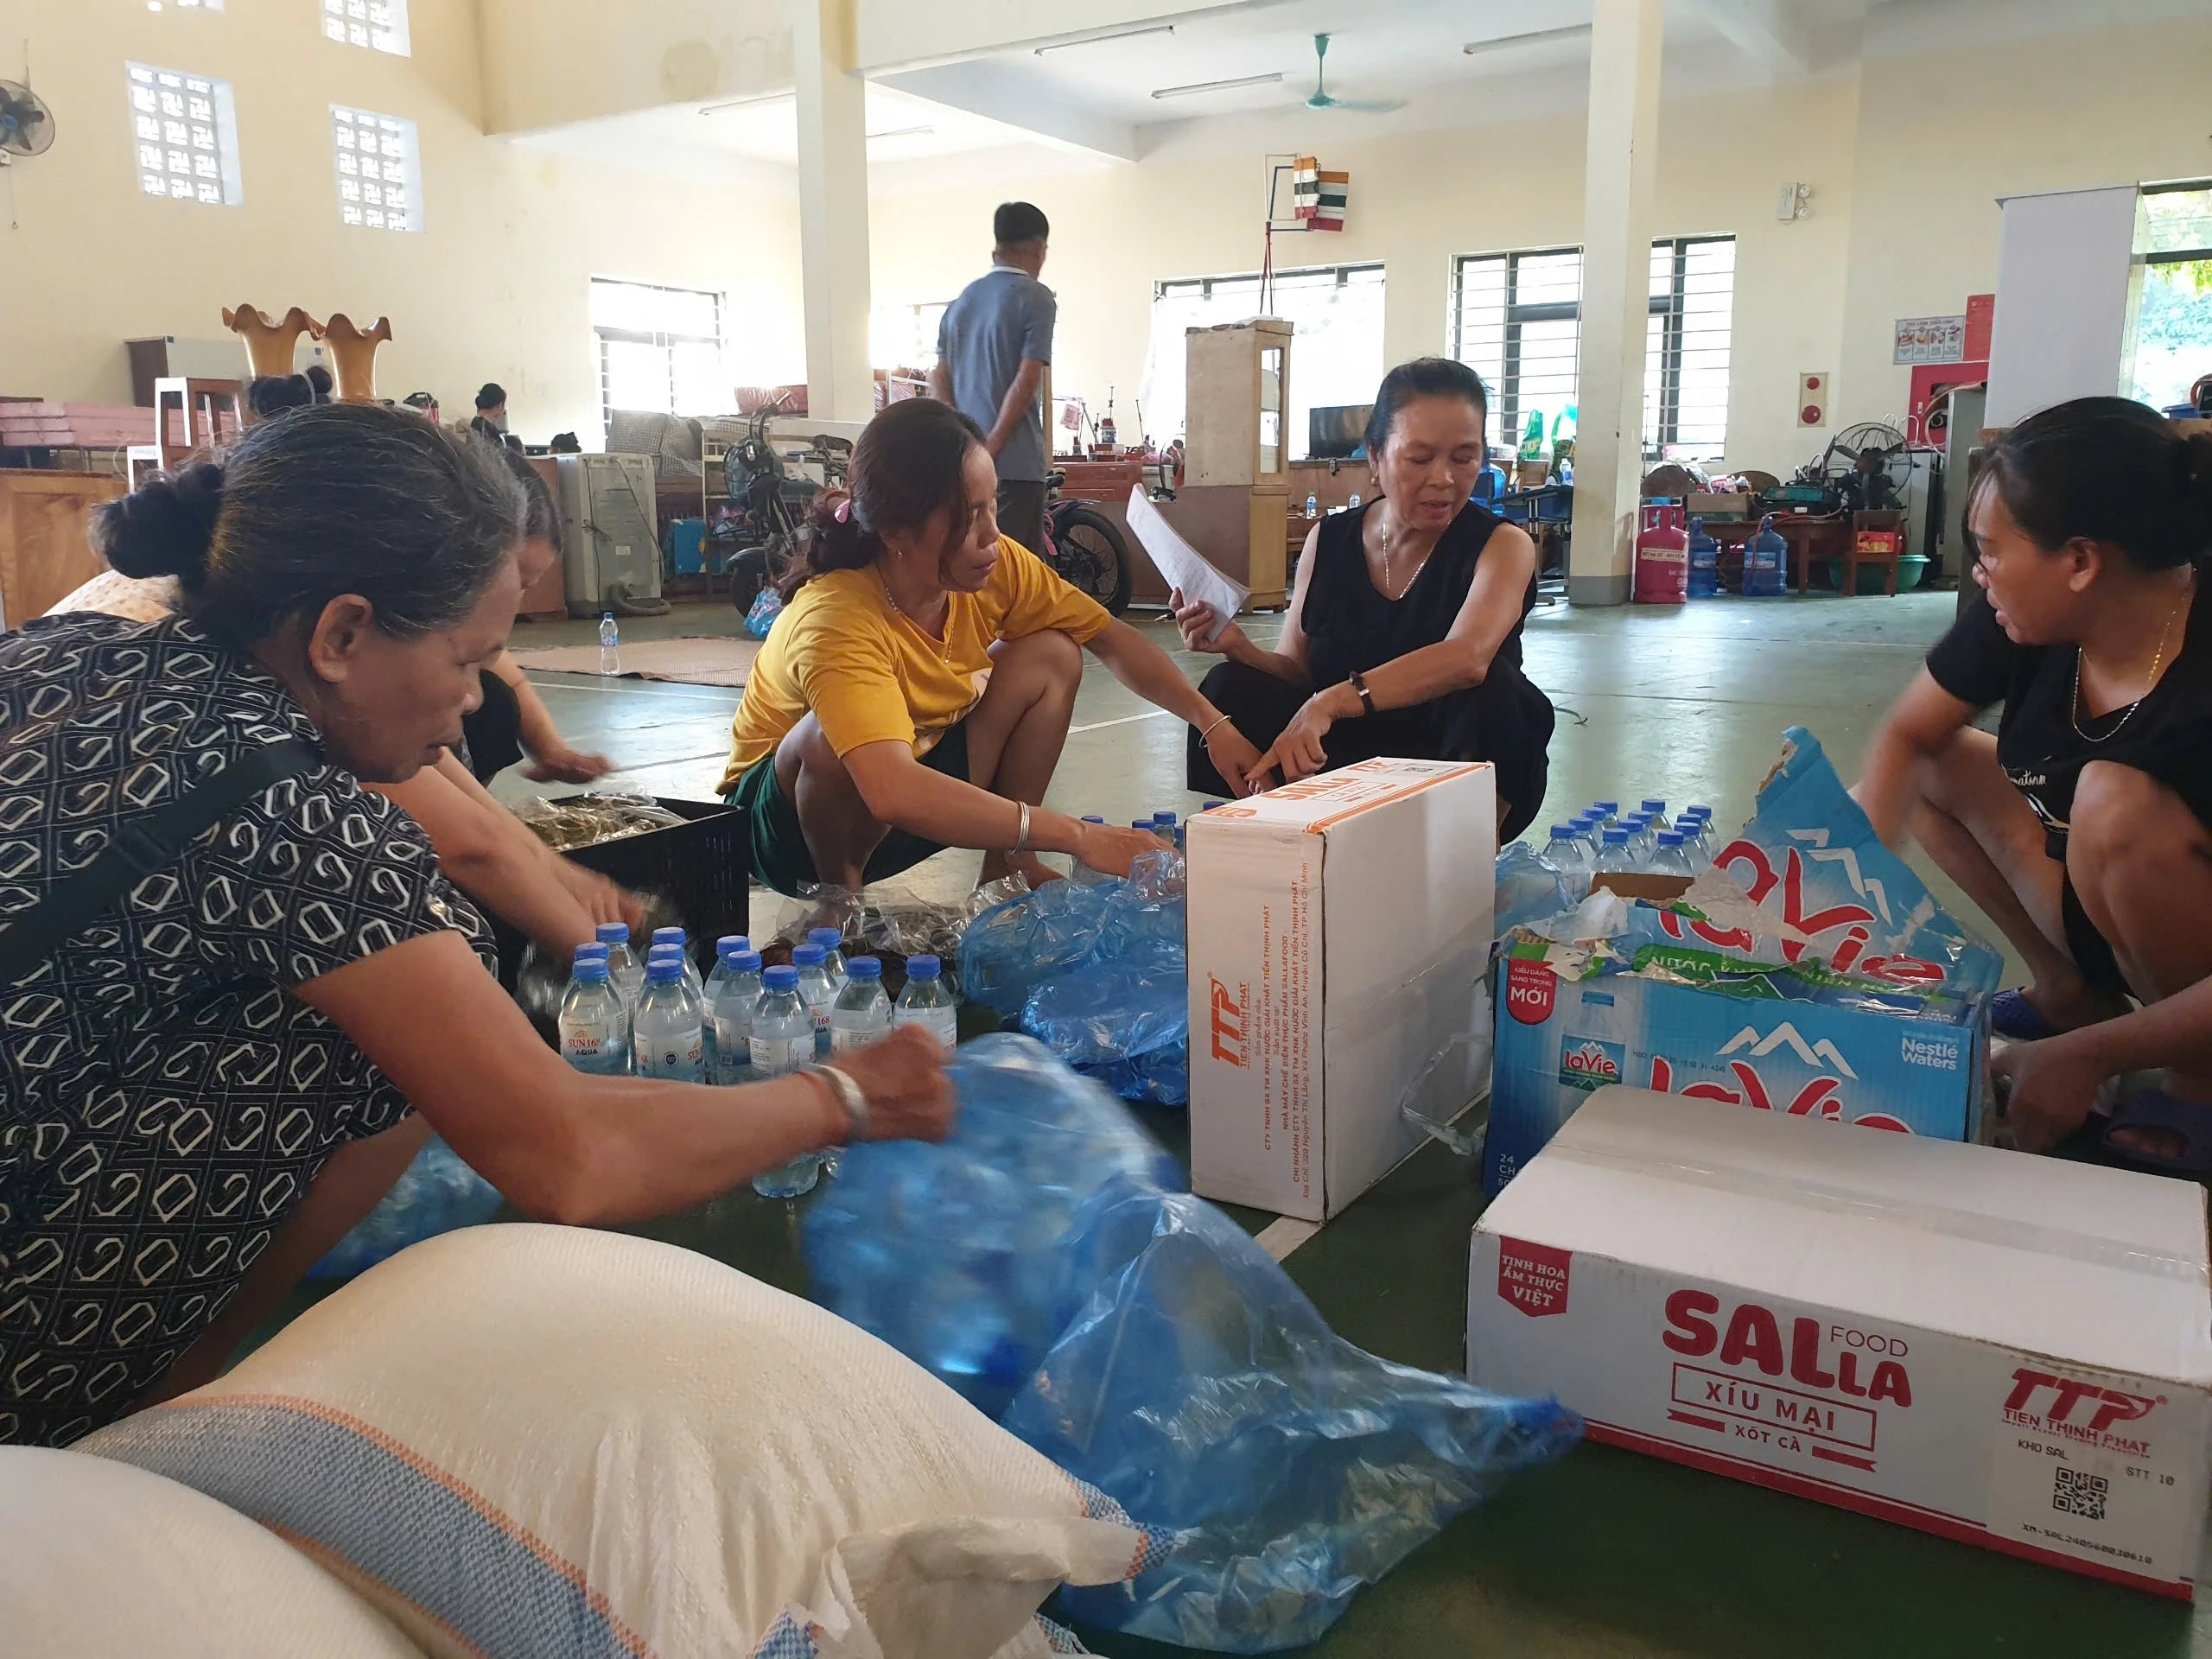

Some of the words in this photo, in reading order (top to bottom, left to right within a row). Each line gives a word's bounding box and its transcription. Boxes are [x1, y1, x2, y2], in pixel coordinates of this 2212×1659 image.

[1510, 986, 1548, 1007] MỚI
[1211, 978, 1239, 1067] TTP
[1902, 1037, 1959, 1058] Nestlé
[1294, 1058, 1299, 1069] TM
[1565, 1050, 1617, 1074] laVie
[1901, 1051, 1957, 1071] Waters
[1264, 1078, 1270, 1090] TM
[1294, 1074, 1299, 1084] SX
[1264, 1093, 1270, 1104] SX
[1500, 1154, 1514, 1164] 24
[1536, 1262, 1567, 1280] HOA
[1527, 1274, 1563, 1293] THỰC
[1512, 1284, 1554, 1308] VIỆT
[1662, 1288, 1912, 1407] SALLA
[1830, 1325, 1909, 1357] FOOD
[1705, 1381, 1760, 1411] XÍU
[1776, 1398, 1835, 1433] MẠI
[2004, 1368, 2155, 1432] TTP
[1778, 1432, 1802, 1453] CÀ
[2018, 1439, 2042, 1453] KHO
[2046, 1446, 2069, 1460] SAL
[2126, 1466, 2150, 1480] STT
[2159, 1474, 2175, 1486] 10
